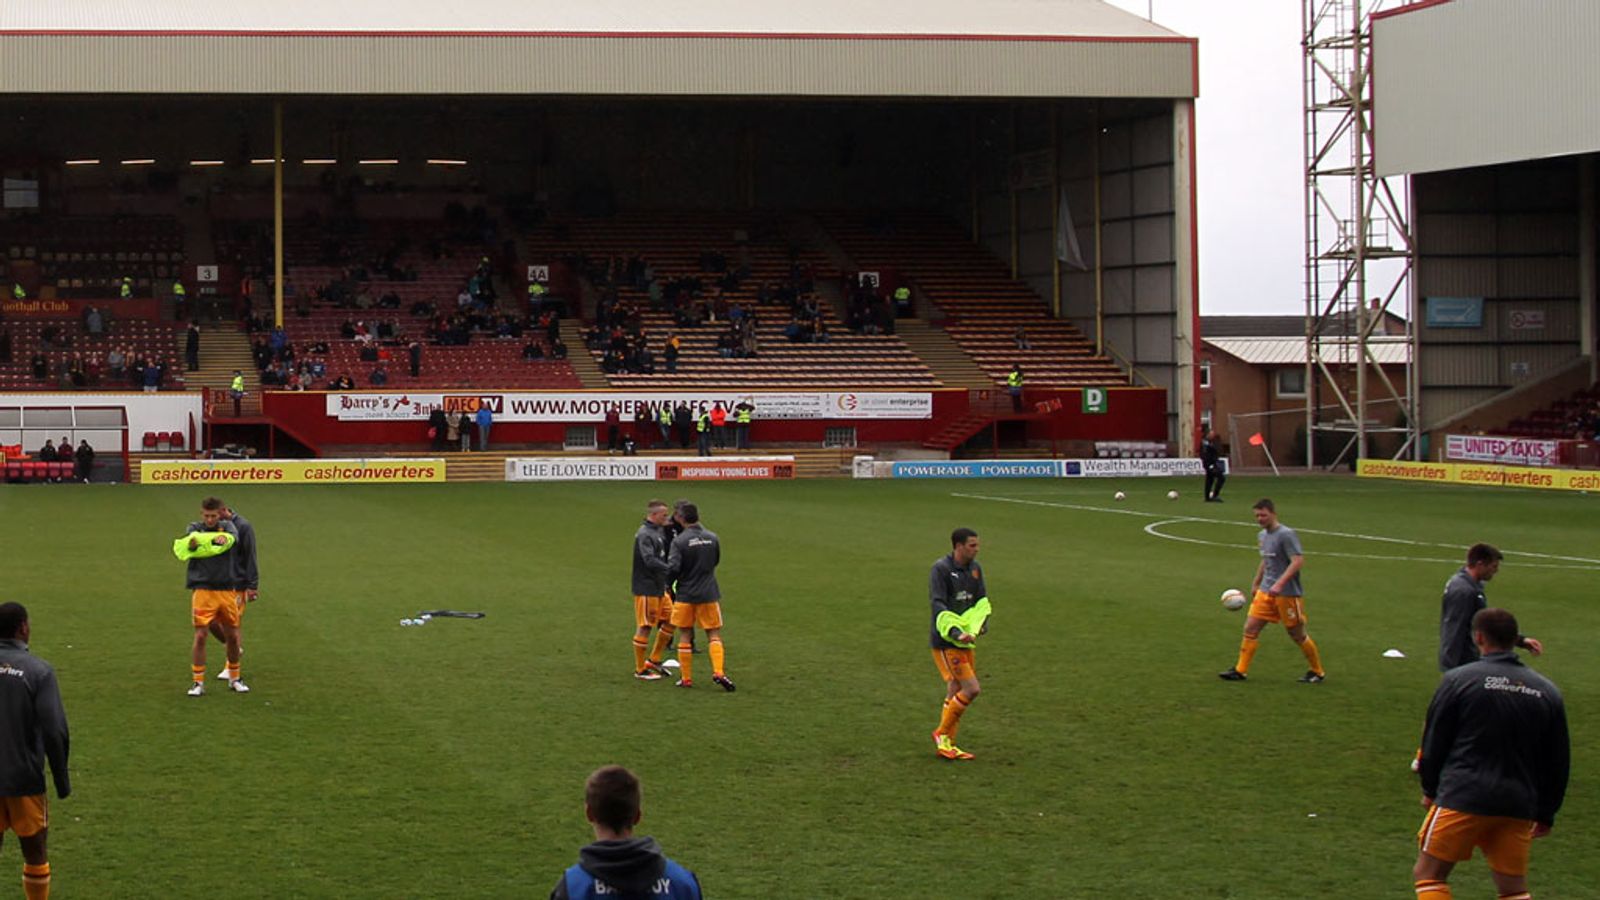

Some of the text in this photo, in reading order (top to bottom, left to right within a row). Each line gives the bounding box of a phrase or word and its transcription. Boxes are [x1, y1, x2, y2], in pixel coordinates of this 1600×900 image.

[203, 269, 211, 280] 3
[530, 268, 546, 281] 4A
[42, 301, 69, 312] Club
[1087, 389, 1102, 405] D
[447, 398, 475, 411] MFC
[481, 397, 500, 411] TV
[1464, 438, 1545, 457] UNITED TAXIS
[151, 465, 283, 480] cashconverters
[304, 465, 435, 479] cashconverters
[681, 467, 719, 476] INSPIRING
[721, 467, 746, 476] YOUNG
[748, 467, 768, 476] LIVES
[899, 465, 973, 476] POWERADE
[981, 465, 1051, 476] POWERADE
[1084, 460, 1126, 471] Wealth
[1129, 460, 1202, 473] Managemen
[1362, 462, 1446, 480] cashconverters
[1460, 468, 1553, 486] cashconverters
[1569, 474, 1600, 489] cash
[1485, 676, 1509, 684] cash
[1484, 682, 1541, 698] converters
